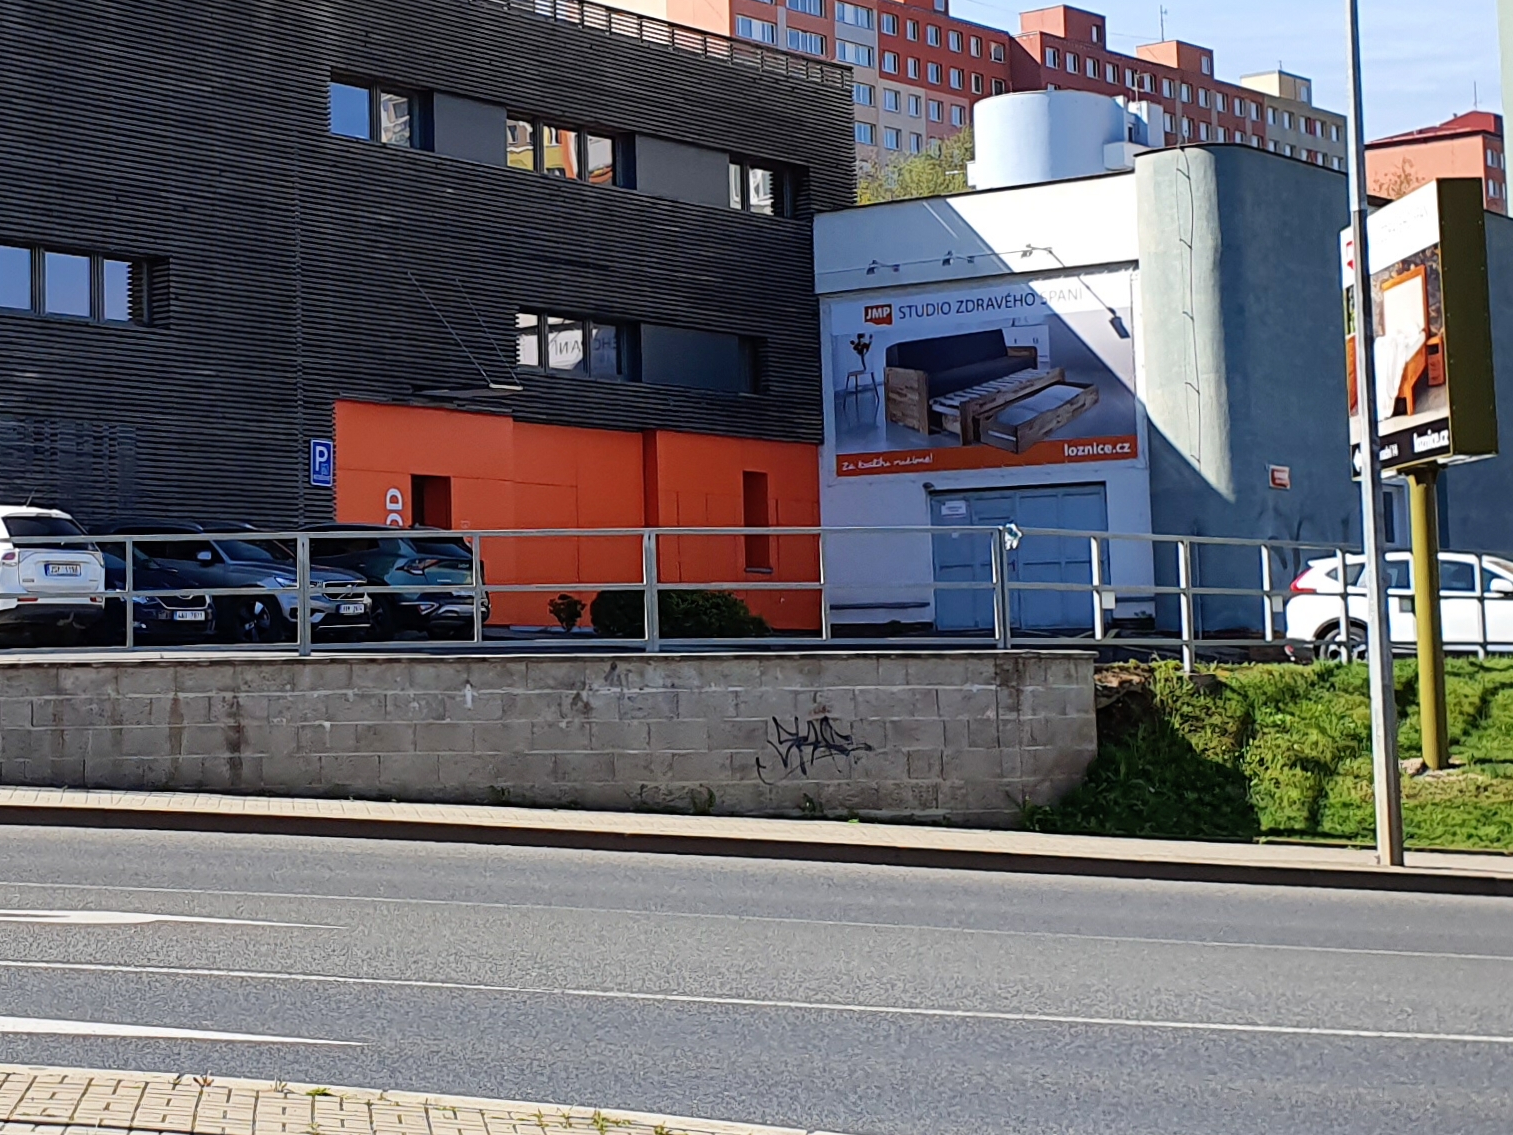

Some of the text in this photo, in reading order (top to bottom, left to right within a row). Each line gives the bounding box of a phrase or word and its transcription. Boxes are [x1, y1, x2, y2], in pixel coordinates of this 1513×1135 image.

[866, 306, 891, 321] JMP
[898, 301, 952, 320] STUDIO
[955, 292, 1036, 314] ZDRAVÉHO
[315, 445, 329, 472] P
[1064, 442, 1132, 457] loznice.cz
